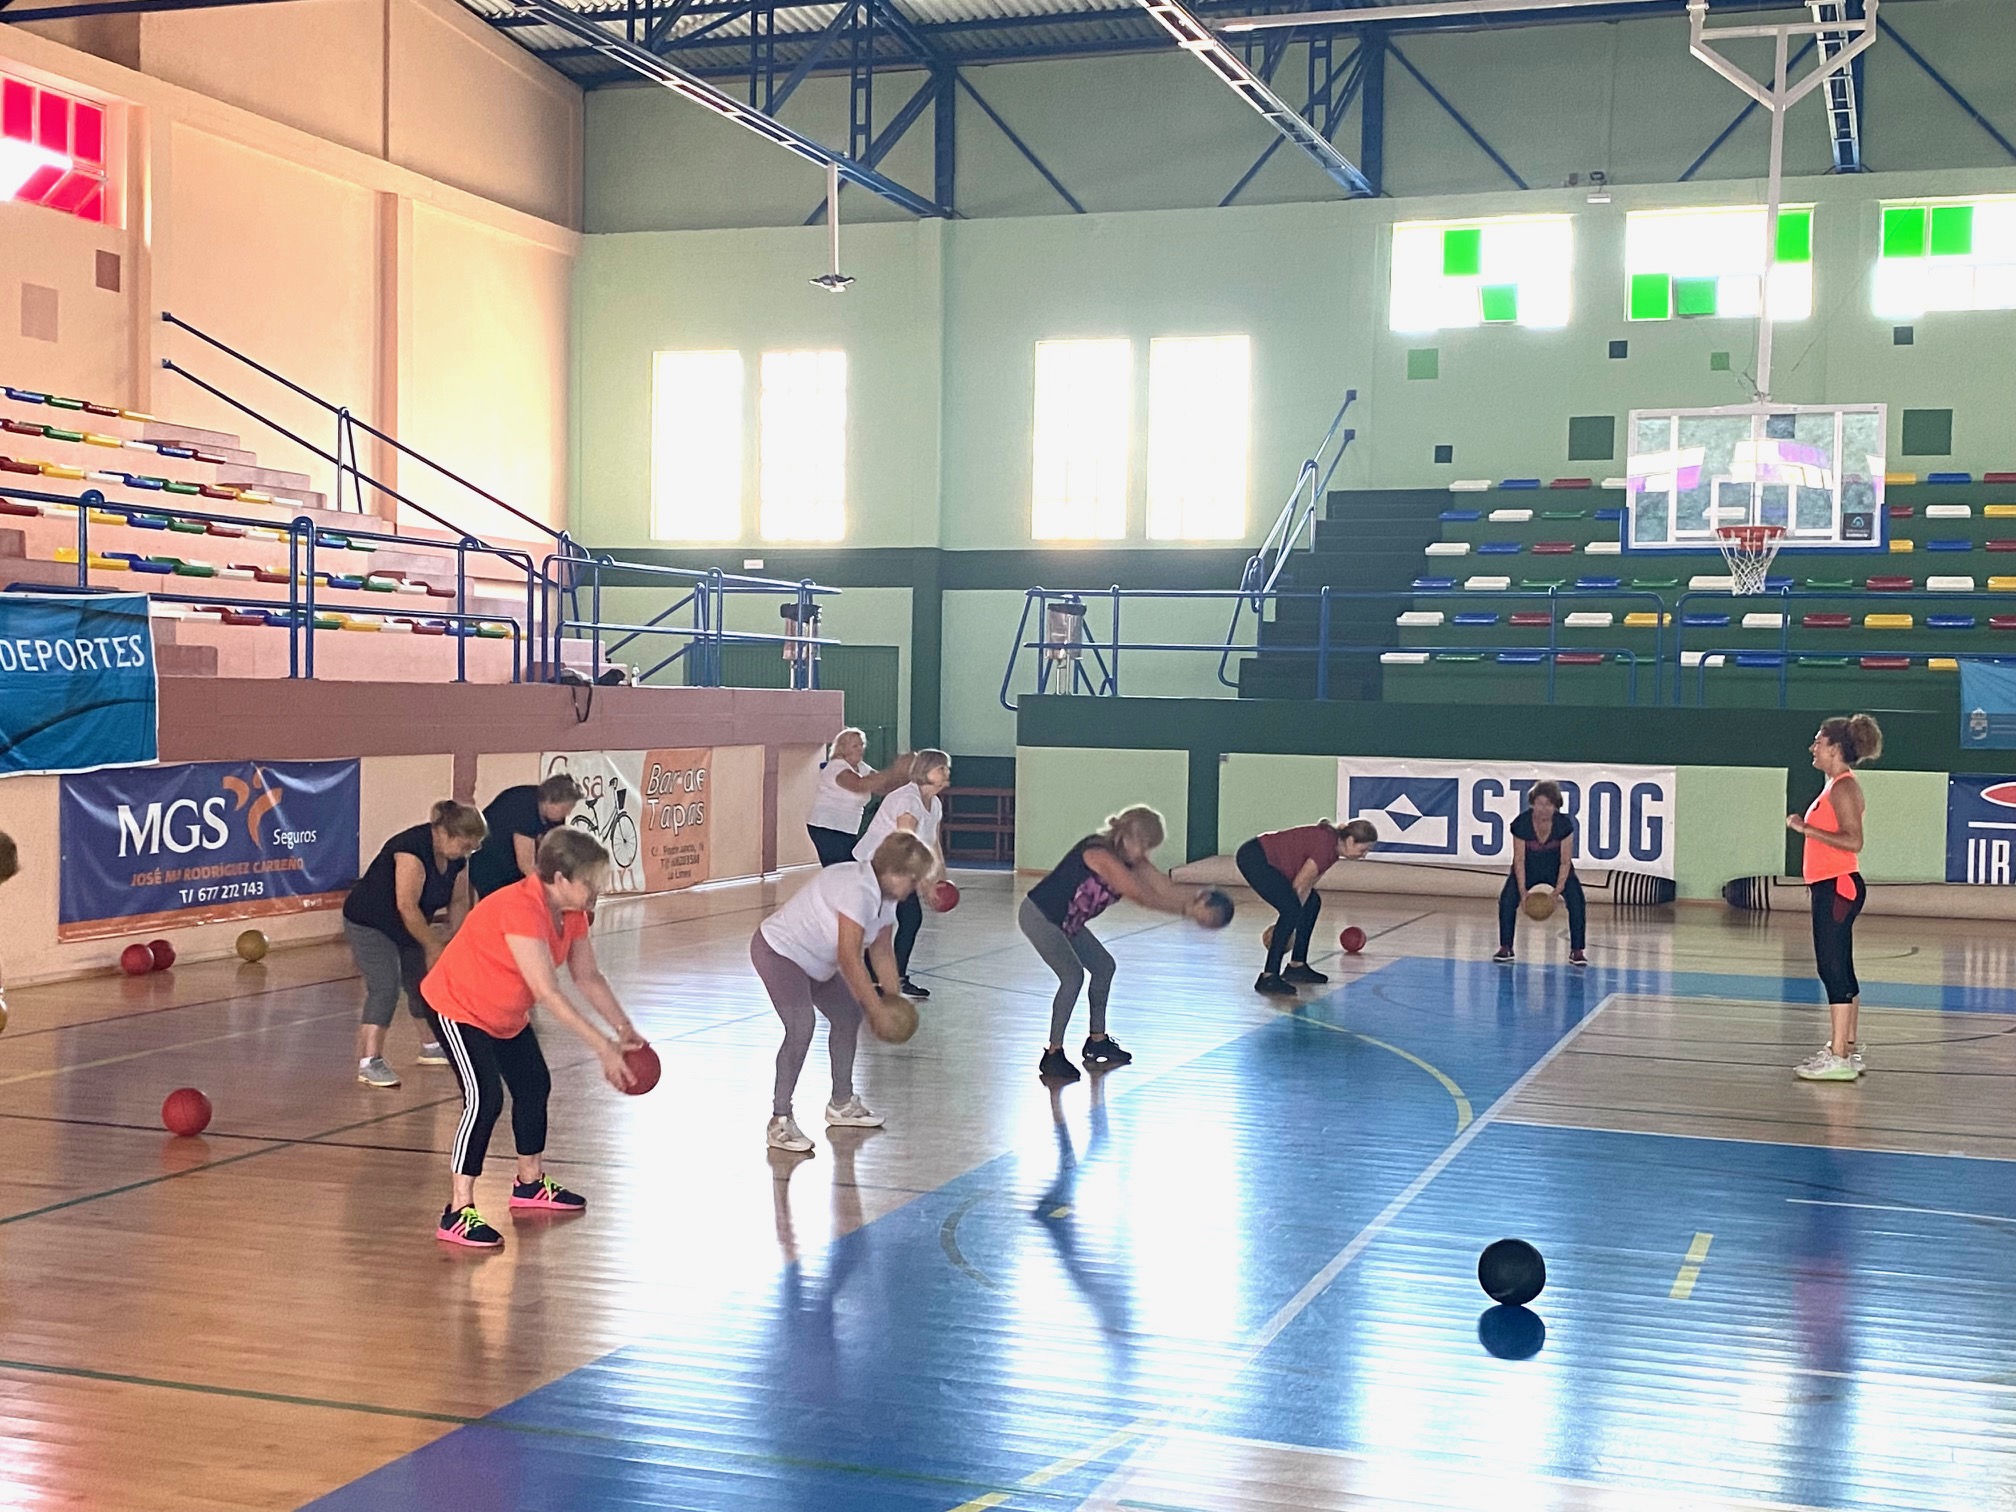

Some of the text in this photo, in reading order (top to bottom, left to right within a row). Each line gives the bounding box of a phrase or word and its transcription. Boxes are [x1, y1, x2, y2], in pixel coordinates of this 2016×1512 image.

[0, 634, 146, 672] DEPORTES
[646, 762, 707, 796] Bar de
[117, 796, 230, 858] MGS
[647, 797, 705, 836] Tapas
[273, 828, 317, 850] Seguros
[130, 867, 162, 887] JOSÉ
[253, 856, 304, 873] CARREÑO
[197, 886, 220, 902] 677
[221, 884, 240, 899] 272
[242, 881, 264, 896] 743
